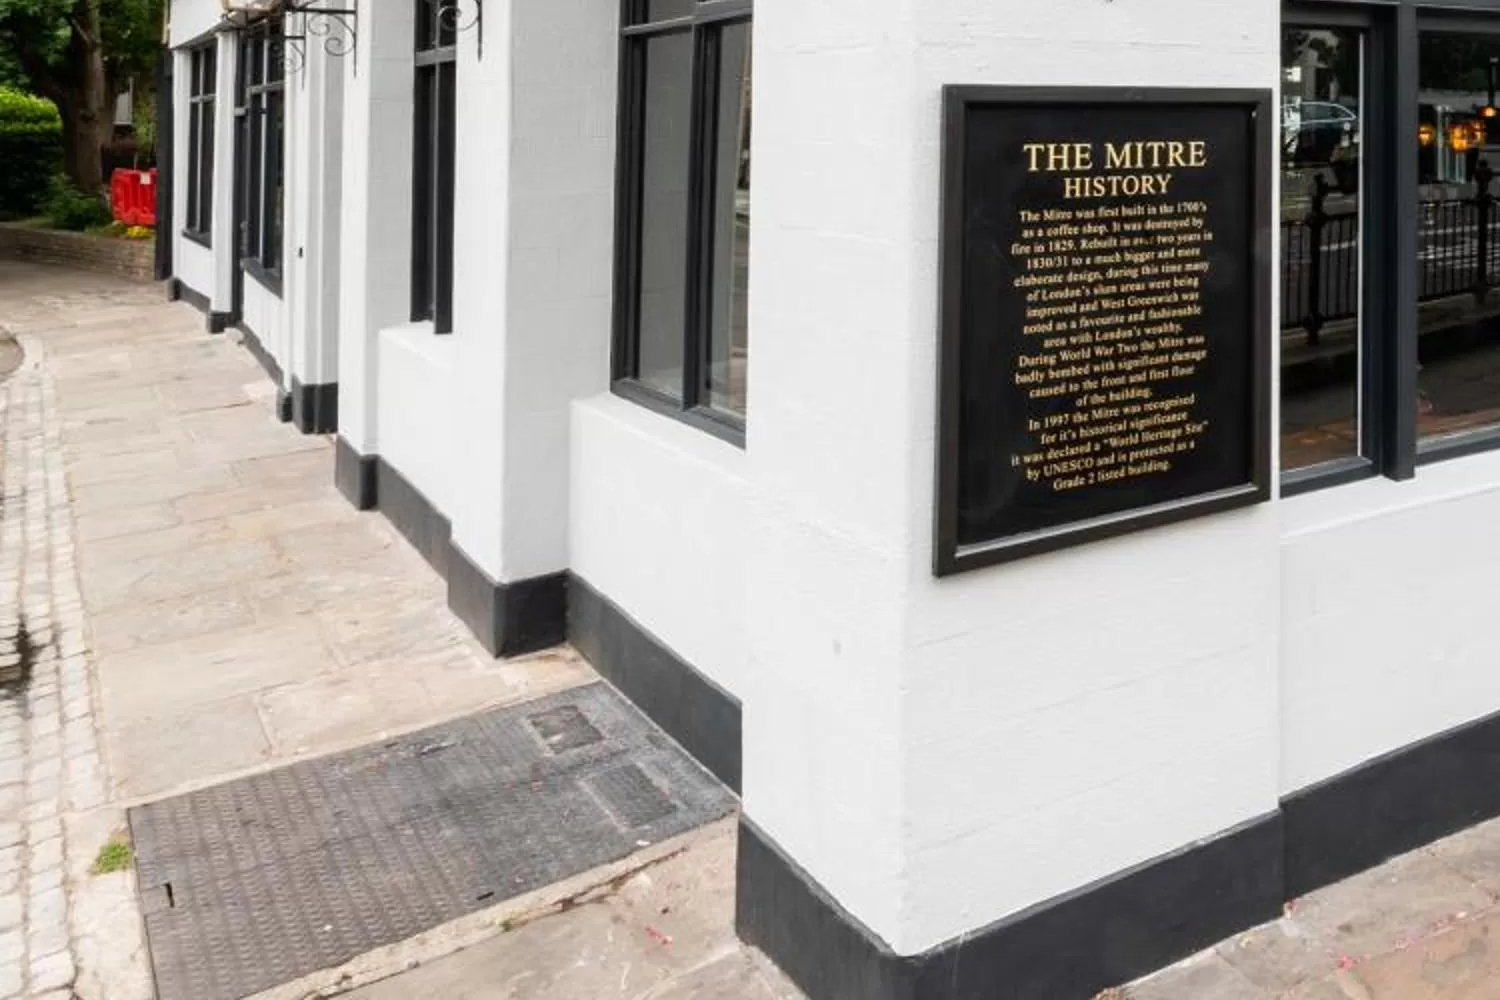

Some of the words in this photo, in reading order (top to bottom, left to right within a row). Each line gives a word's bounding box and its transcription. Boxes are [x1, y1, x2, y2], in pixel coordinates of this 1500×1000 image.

[1023, 143, 1093, 172] THE
[1104, 141, 1207, 169] MITRE
[1063, 174, 1172, 199] HISTORY
[1019, 210, 1040, 222] The
[1043, 209, 1072, 220] Mitre
[1076, 209, 1095, 219] was
[1098, 207, 1119, 217] first
[1121, 204, 1144, 216] built
[1147, 204, 1157, 214] in
[1160, 203, 1174, 214] the
[1022, 229, 1034, 238] as
[1037, 228, 1043, 237] a
[1046, 225, 1078, 237] coffee
[1113, 222, 1120, 232] It
[1124, 222, 1141, 231] was
[1144, 218, 1189, 231] destroyed
[1192, 217, 1203, 229] by
[1011, 243, 1030, 255] fire
[1034, 243, 1044, 253] in
[1080, 236, 1117, 250] Rebuilt
[1120, 236, 1130, 247] in
[1157, 233, 1174, 243] two
[1177, 232, 1201, 244] years
[1204, 230, 1213, 241] in
[1027, 255, 1068, 270] 1830/31
[1072, 255, 1082, 266] to
[1094, 252, 1121, 264] much
[1124, 251, 1155, 262] bigger
[1158, 247, 1174, 259] and
[1177, 247, 1200, 257] more
[1013, 272, 1062, 287] elaborate
[1106, 268, 1139, 279] during
[1142, 265, 1158, 275] this
[1161, 263, 1182, 273] time
[1185, 262, 1209, 272] many
[1026, 290, 1040, 301] of
[1041, 285, 1090, 300] London's
[1120, 283, 1145, 293] areas
[1148, 280, 1170, 289] were
[1174, 276, 1199, 289] being
[1026, 303, 1076, 319] improved
[1079, 301, 1098, 312] and
[1101, 298, 1125, 309] West
[1128, 292, 1178, 307] Greenwich
[1181, 292, 1199, 301] was
[1023, 322, 1052, 334] noted
[1056, 321, 1067, 330] as
[1070, 321, 1076, 329] a
[1079, 314, 1124, 328] favourite
[1128, 311, 1145, 322] and
[1148, 304, 1201, 320] fashionable
[1044, 338, 1066, 348] area
[1070, 333, 1093, 344] with
[1095, 326, 1141, 341] London's
[1019, 353, 1057, 368] During
[1059, 348, 1091, 361] World
[1095, 346, 1114, 357] War
[1118, 343, 1138, 353] Two
[1141, 340, 1156, 350] the
[1159, 338, 1184, 348] Mitre
[1187, 335, 1205, 344] was
[1015, 370, 1044, 385] badly
[1048, 365, 1090, 379] bombed
[1094, 359, 1114, 372] with
[1118, 354, 1169, 370] significant
[1172, 349, 1207, 362] damage
[1029, 383, 1066, 398] caused
[1070, 382, 1080, 392] to
[1083, 378, 1099, 390] the
[1101, 375, 1126, 388] front
[1129, 372, 1147, 383] and
[1150, 369, 1169, 380] first
[1076, 396, 1087, 407] of
[1090, 393, 1106, 404] the
[1028, 419, 1040, 431] In
[1073, 412, 1089, 423] the
[1092, 407, 1119, 420] Mitre
[1123, 404, 1141, 414] was
[1041, 434, 1056, 444] for
[1079, 423, 1127, 438] historical
[1129, 411, 1187, 430] significance
[1011, 455, 1019, 467] it
[1023, 453, 1043, 463] was
[1047, 442, 1091, 459] declared
[1094, 443, 1100, 451] a
[1142, 427, 1182, 443] Heritage
[1027, 468, 1040, 480] by
[1044, 456, 1094, 476] UNESCO
[1096, 453, 1114, 467] and
[1118, 451, 1126, 463] is
[1129, 442, 1174, 461] protected
[1177, 442, 1186, 451] as
[1189, 440, 1195, 449] a
[1053, 476, 1085, 490] Grade
[1089, 473, 1095, 483] 2
[1097, 466, 1125, 482] listed
